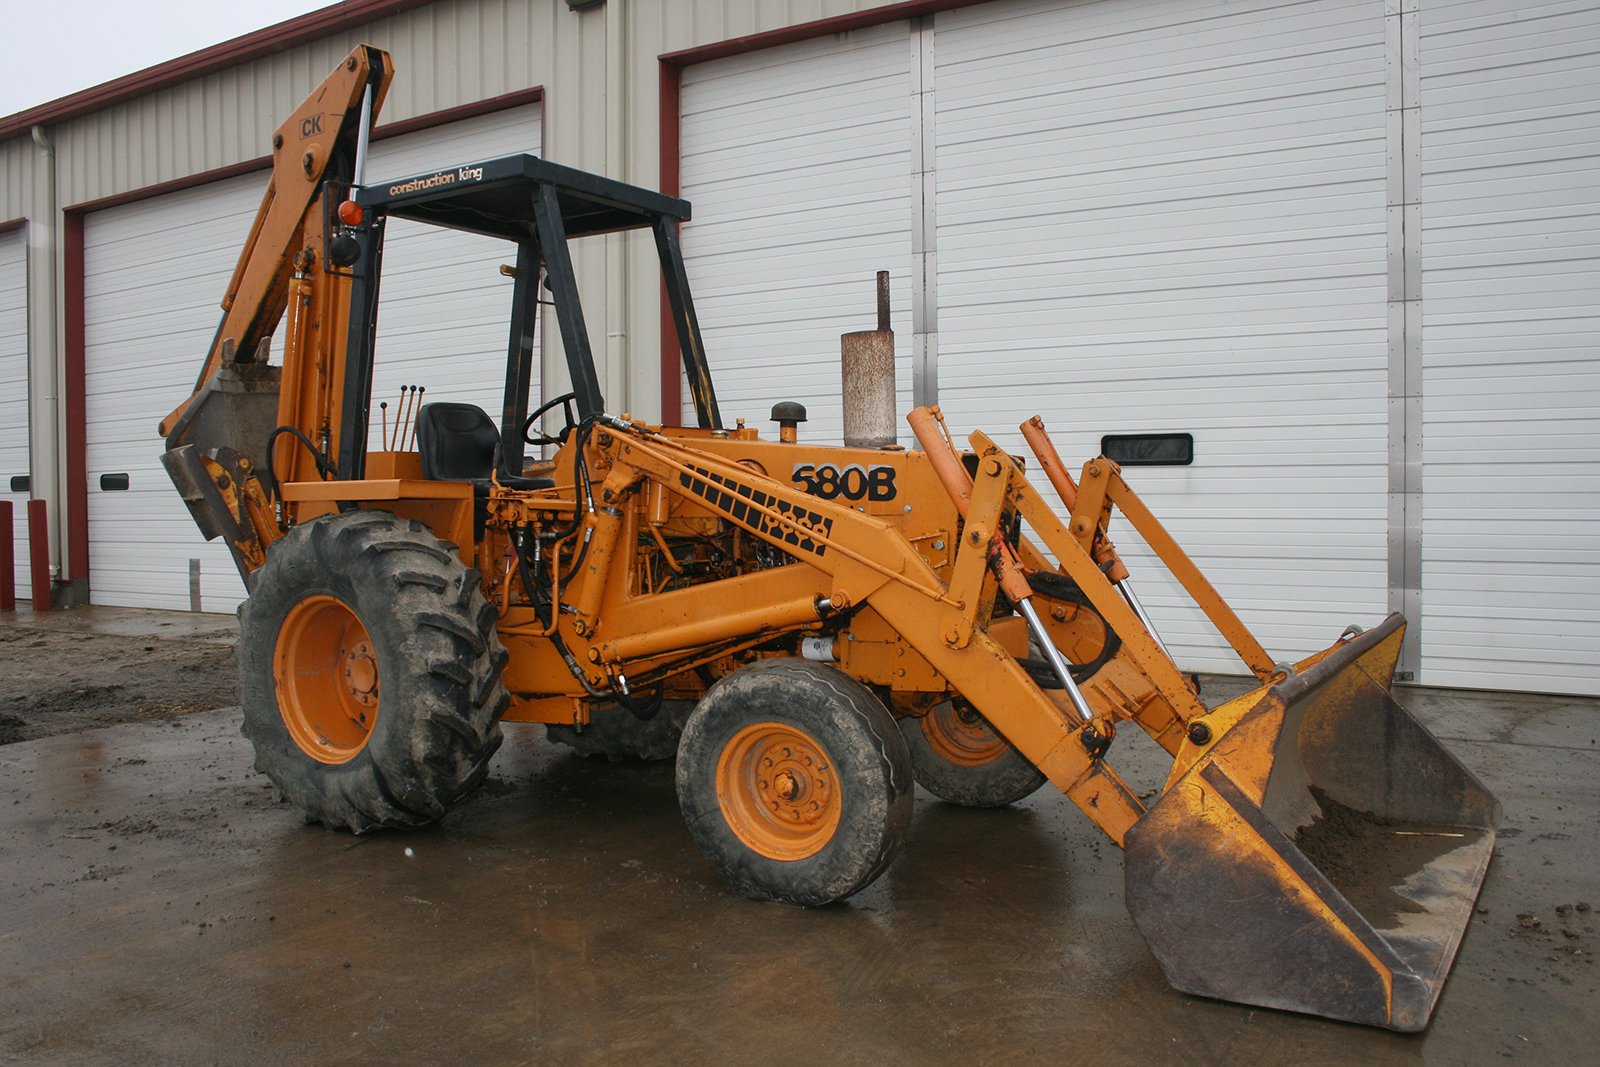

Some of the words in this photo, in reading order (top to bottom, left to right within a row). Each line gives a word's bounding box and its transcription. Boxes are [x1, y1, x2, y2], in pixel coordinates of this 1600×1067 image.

[302, 115, 322, 137] CK
[389, 172, 455, 196] construction
[458, 166, 483, 181] king
[791, 463, 897, 501] 580B
